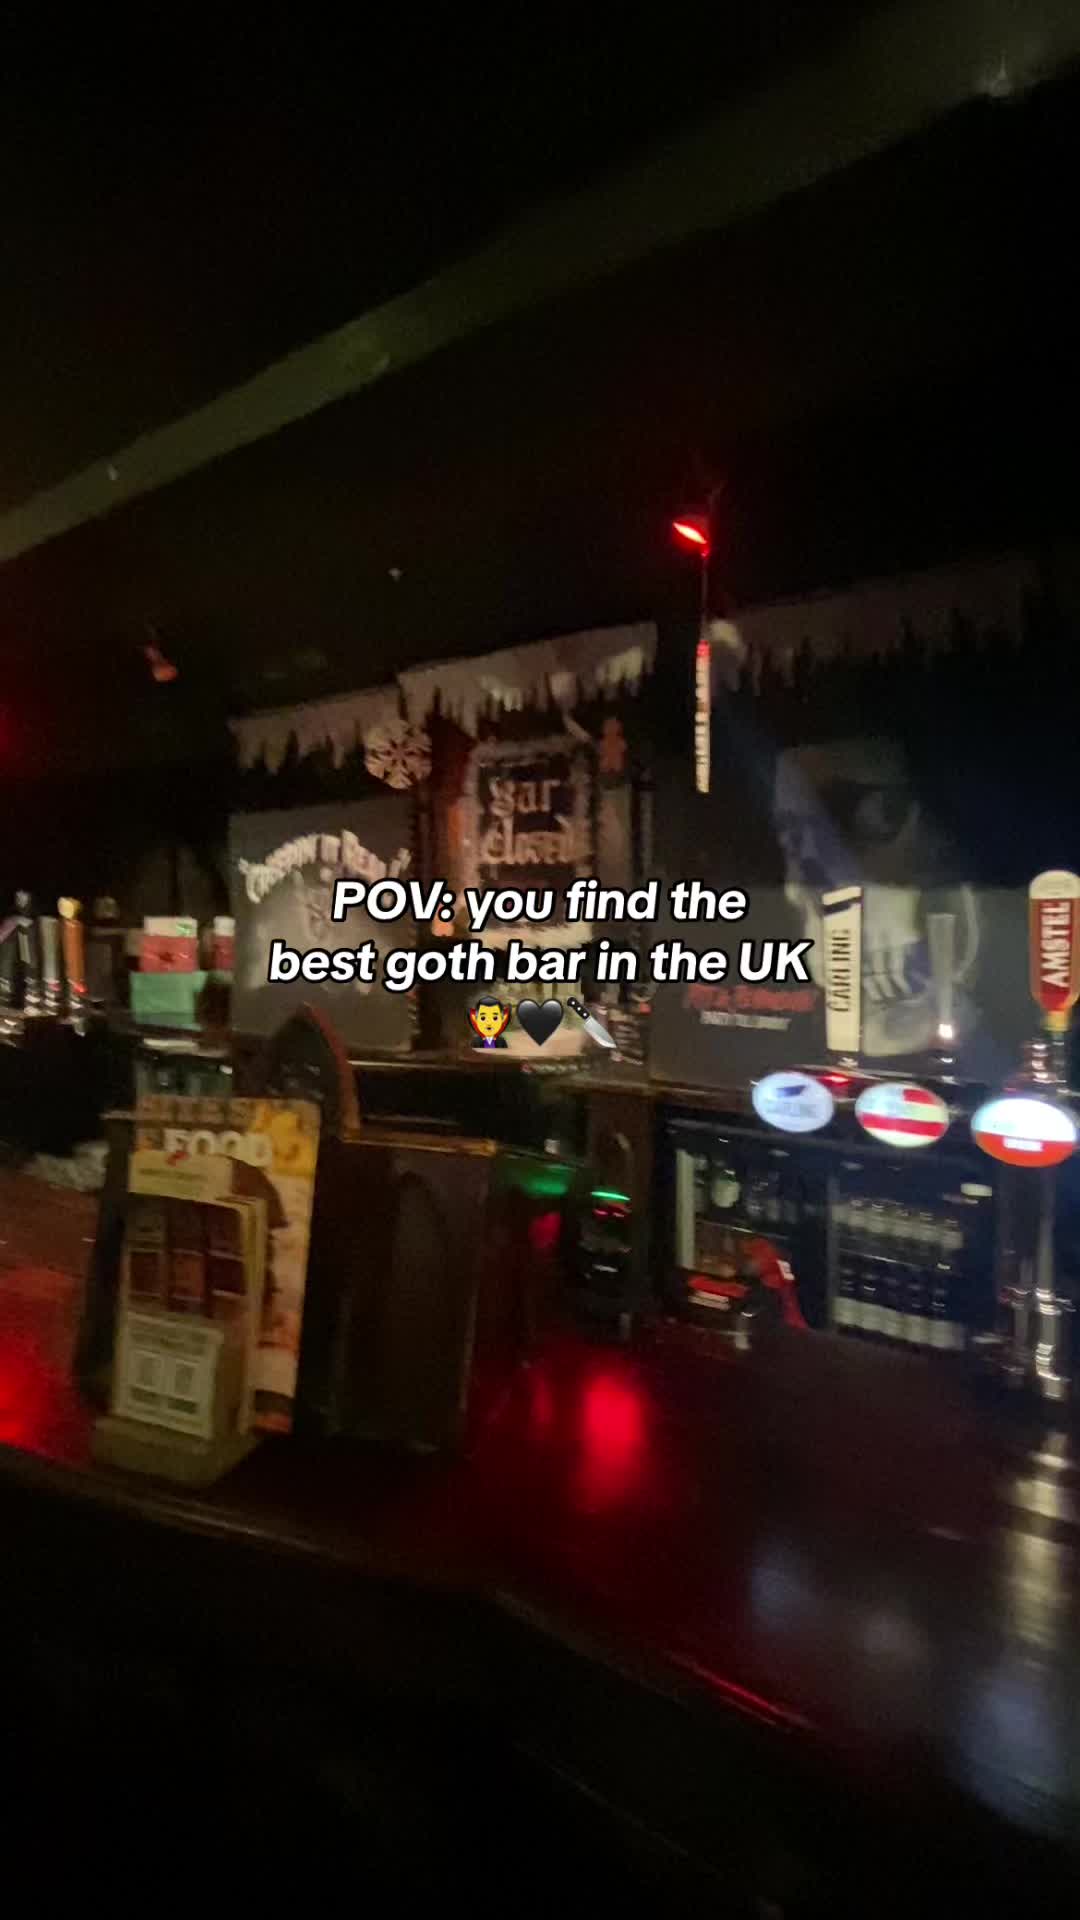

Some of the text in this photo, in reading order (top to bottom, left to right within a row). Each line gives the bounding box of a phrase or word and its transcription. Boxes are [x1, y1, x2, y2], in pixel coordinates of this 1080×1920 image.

[826, 928, 851, 1013] CARLING
[1040, 901, 1071, 988] AMSTEL
[163, 1127, 272, 1168] FOOD
